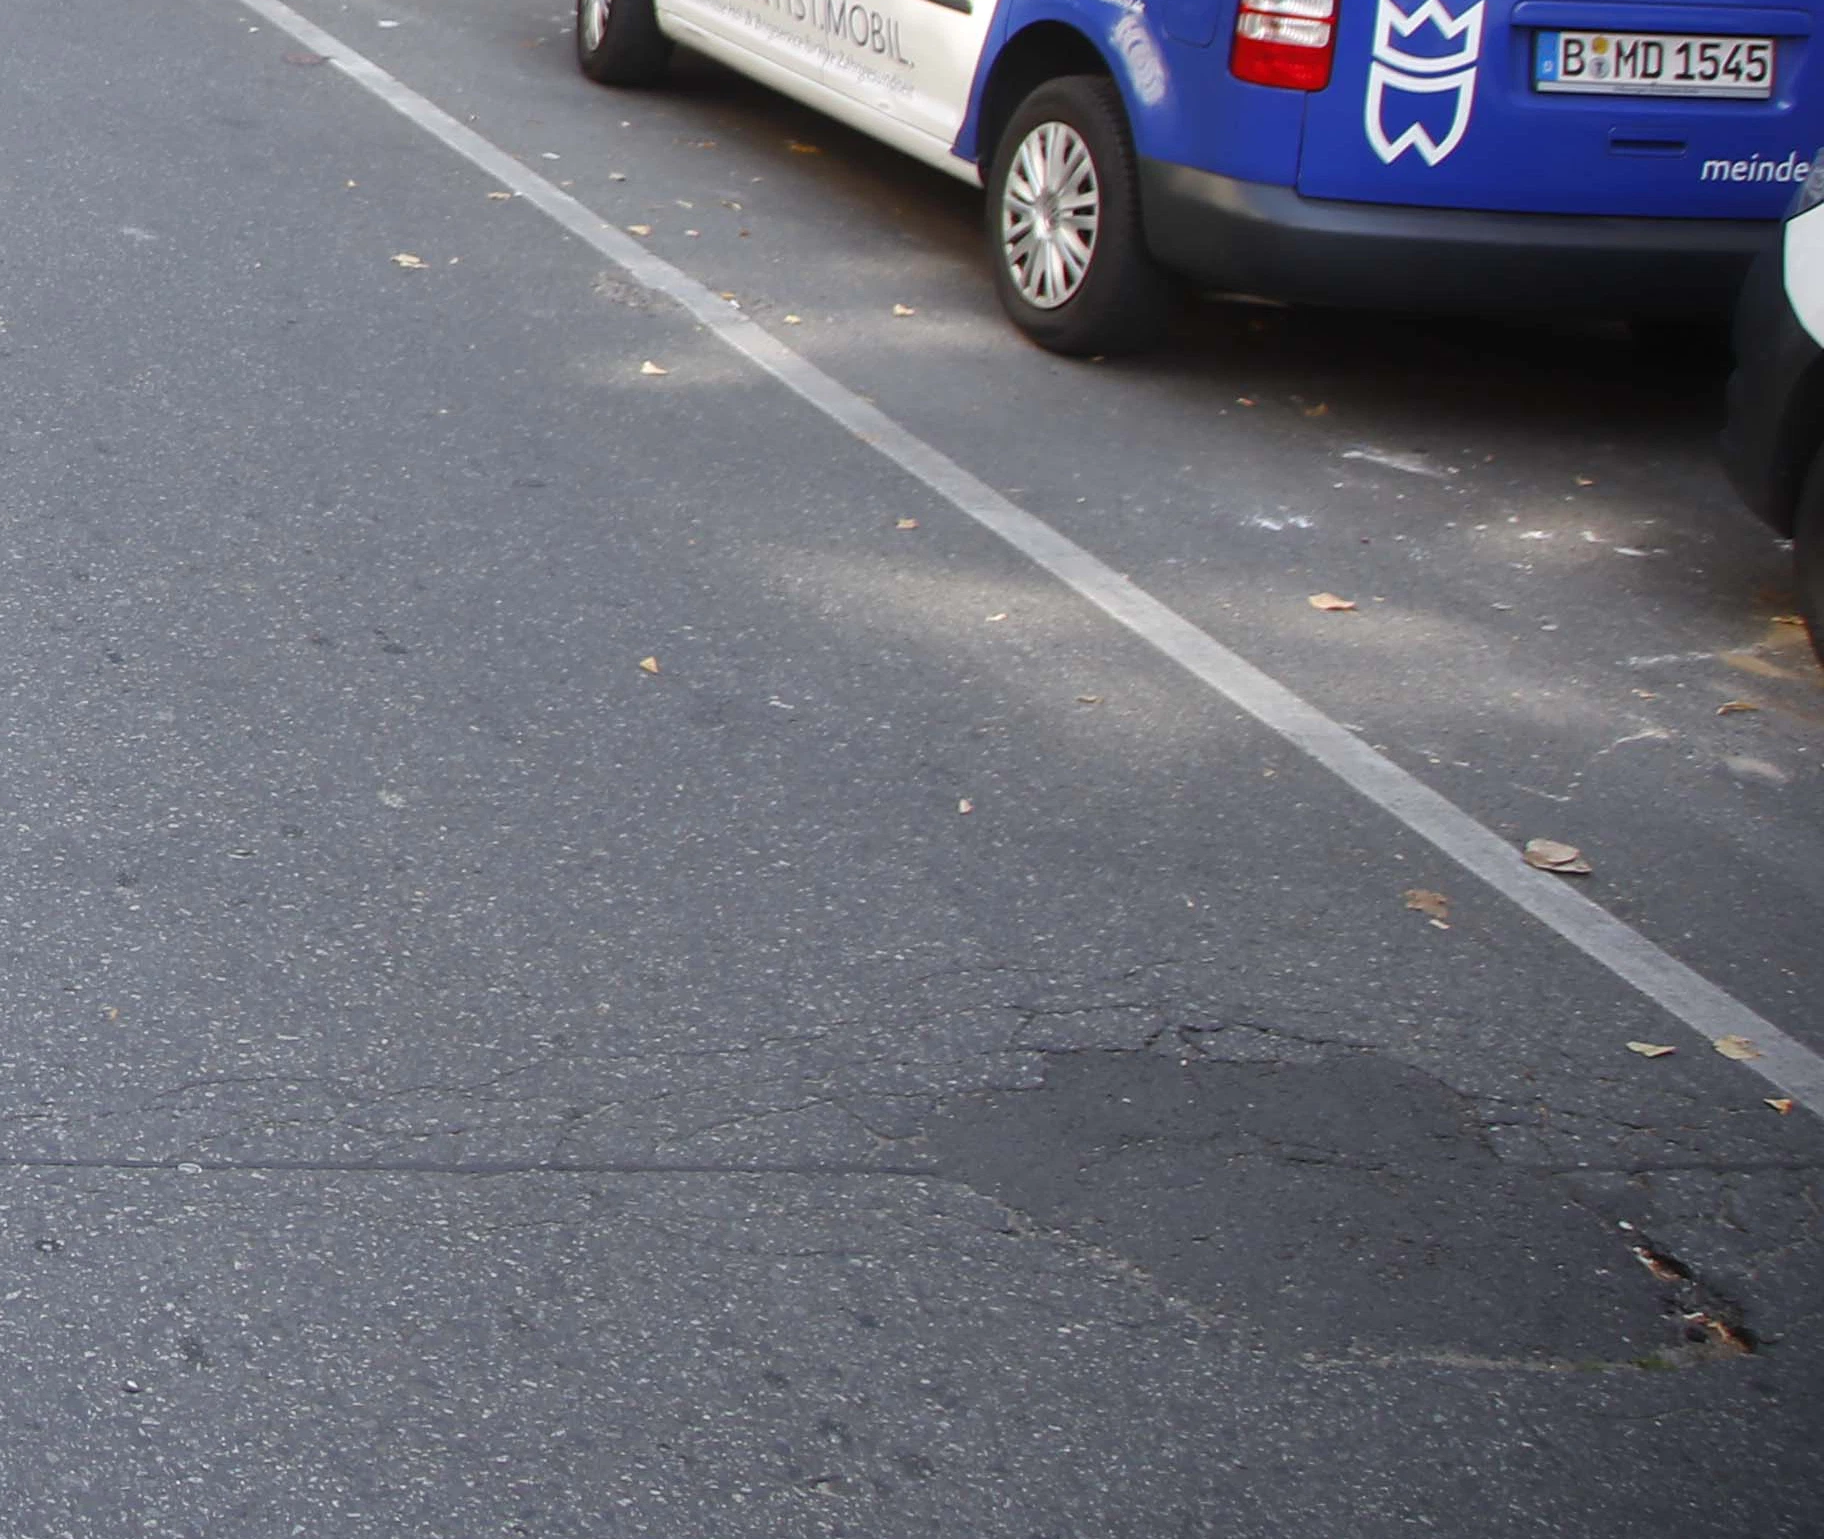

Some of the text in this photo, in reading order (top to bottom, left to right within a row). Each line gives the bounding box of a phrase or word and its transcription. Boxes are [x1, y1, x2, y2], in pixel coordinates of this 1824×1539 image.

[1562, 38, 1770, 82] B MD 1545
